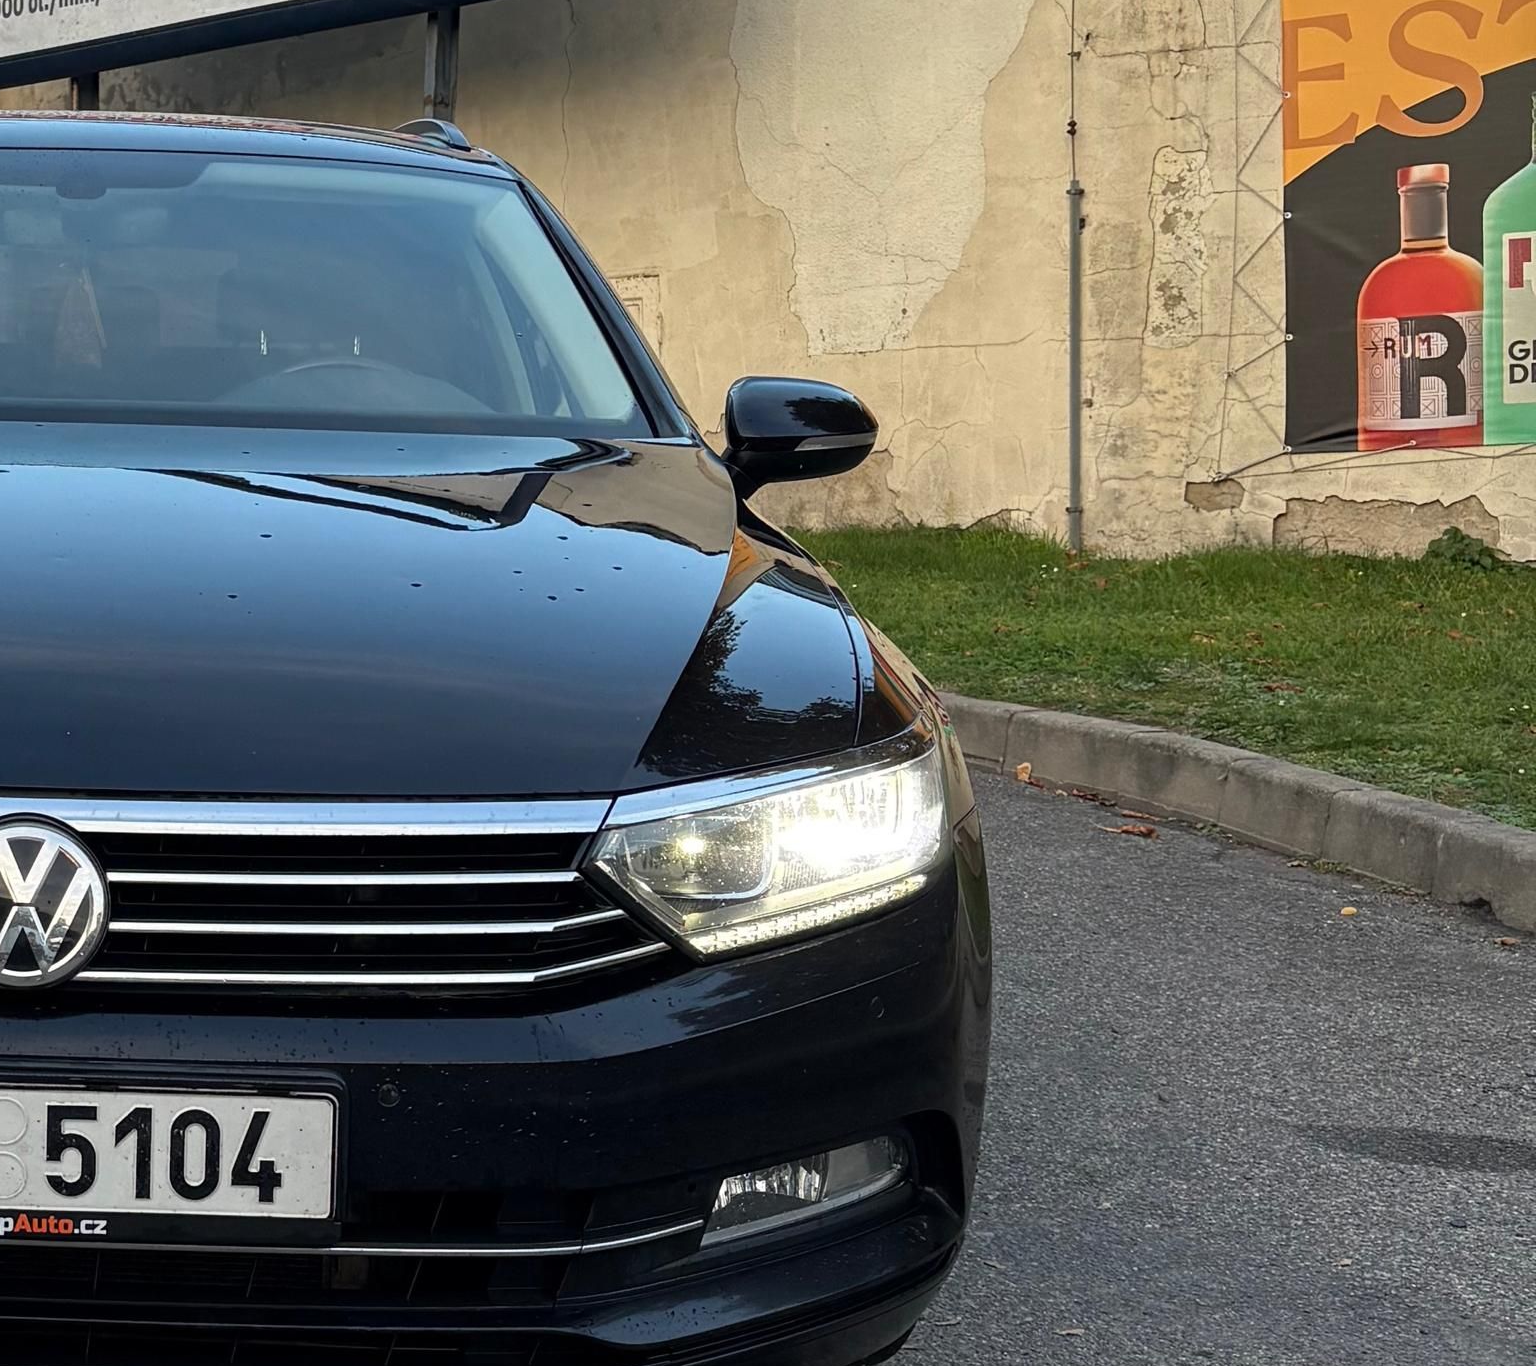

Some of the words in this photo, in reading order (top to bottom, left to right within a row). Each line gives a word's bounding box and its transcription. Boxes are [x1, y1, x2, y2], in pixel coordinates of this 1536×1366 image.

[1384, 334, 1433, 360] RUM
[1400, 314, 1467, 420] R
[44, 1100, 284, 1203] 5104
